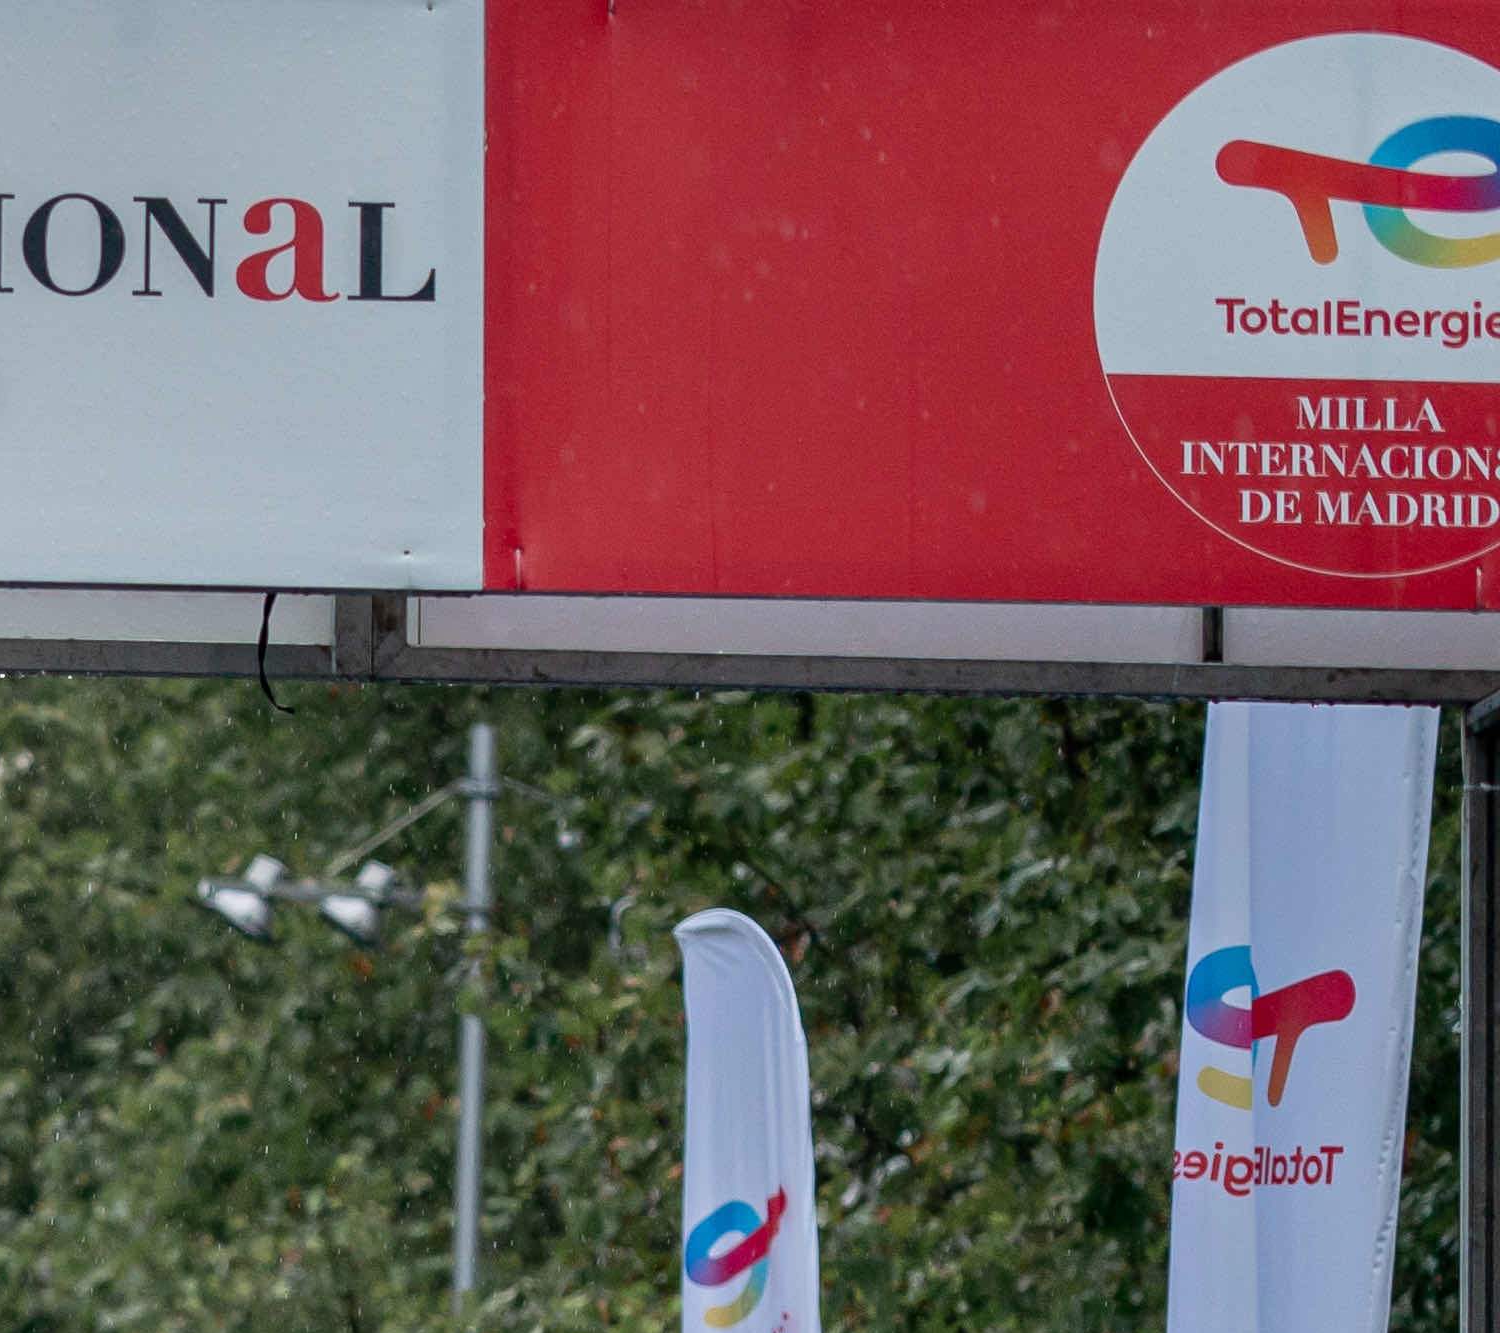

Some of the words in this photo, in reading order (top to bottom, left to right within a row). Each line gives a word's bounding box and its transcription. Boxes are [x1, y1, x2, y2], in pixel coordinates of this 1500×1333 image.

[1296, 396, 1446, 433] MILLA
[1180, 441, 1500, 481] INTERNACION
[1238, 489, 1302, 525] DE
[1315, 490, 1500, 529] MADRID
